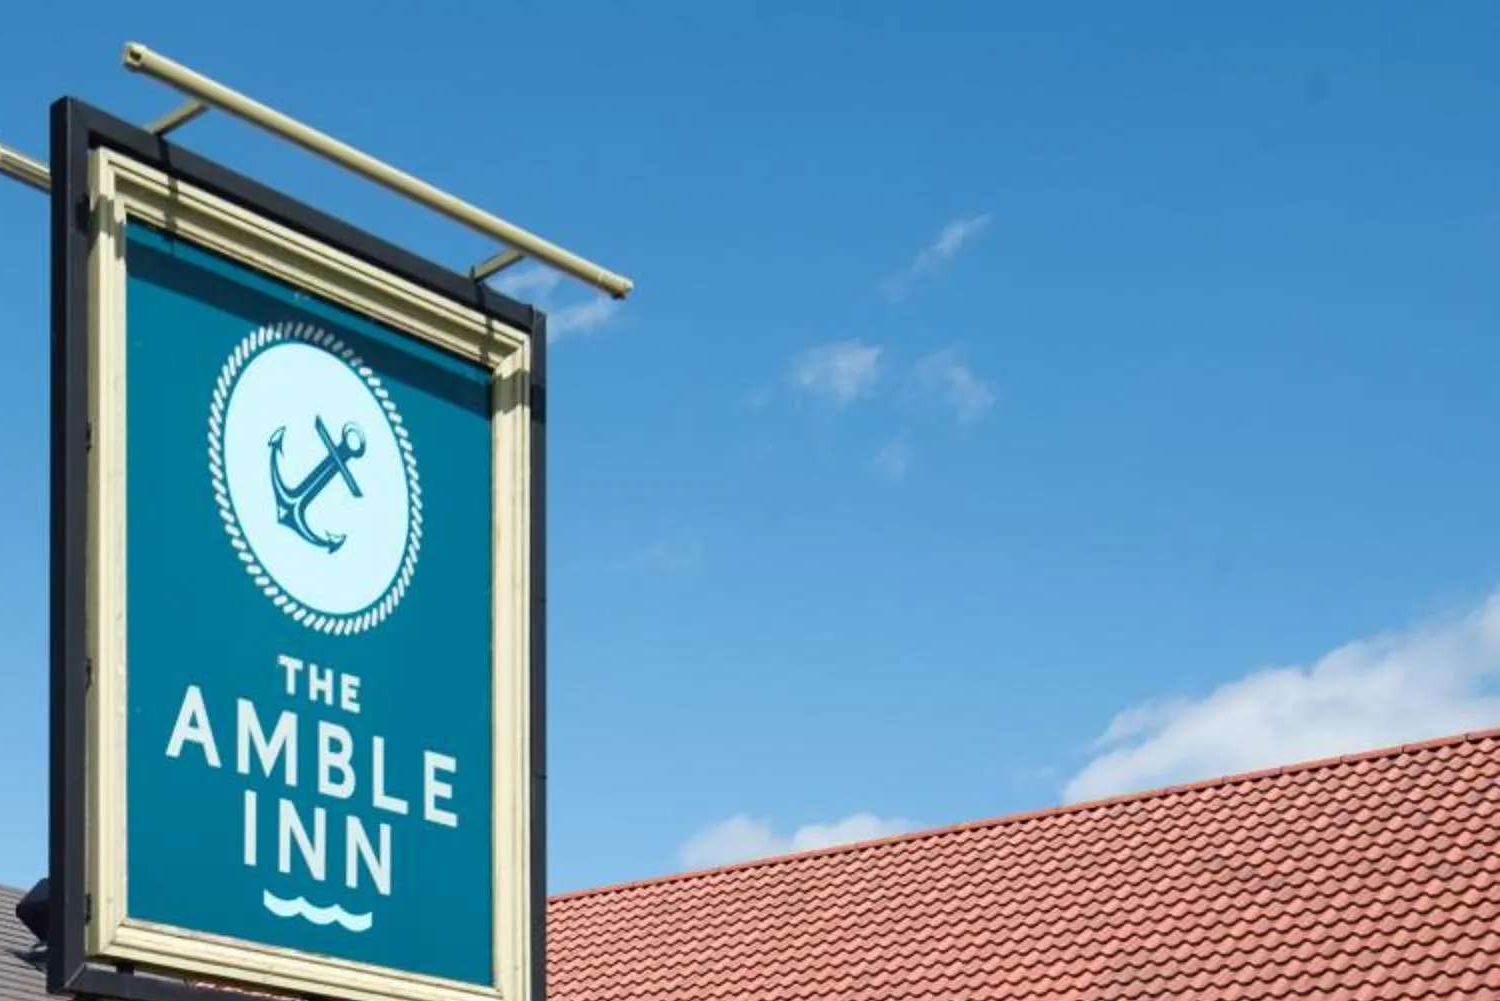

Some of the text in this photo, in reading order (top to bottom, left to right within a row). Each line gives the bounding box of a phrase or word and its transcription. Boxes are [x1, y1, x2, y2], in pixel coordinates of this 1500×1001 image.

[277, 654, 361, 714] THE
[165, 684, 459, 829] AMBLE
[243, 789, 391, 897] INN
